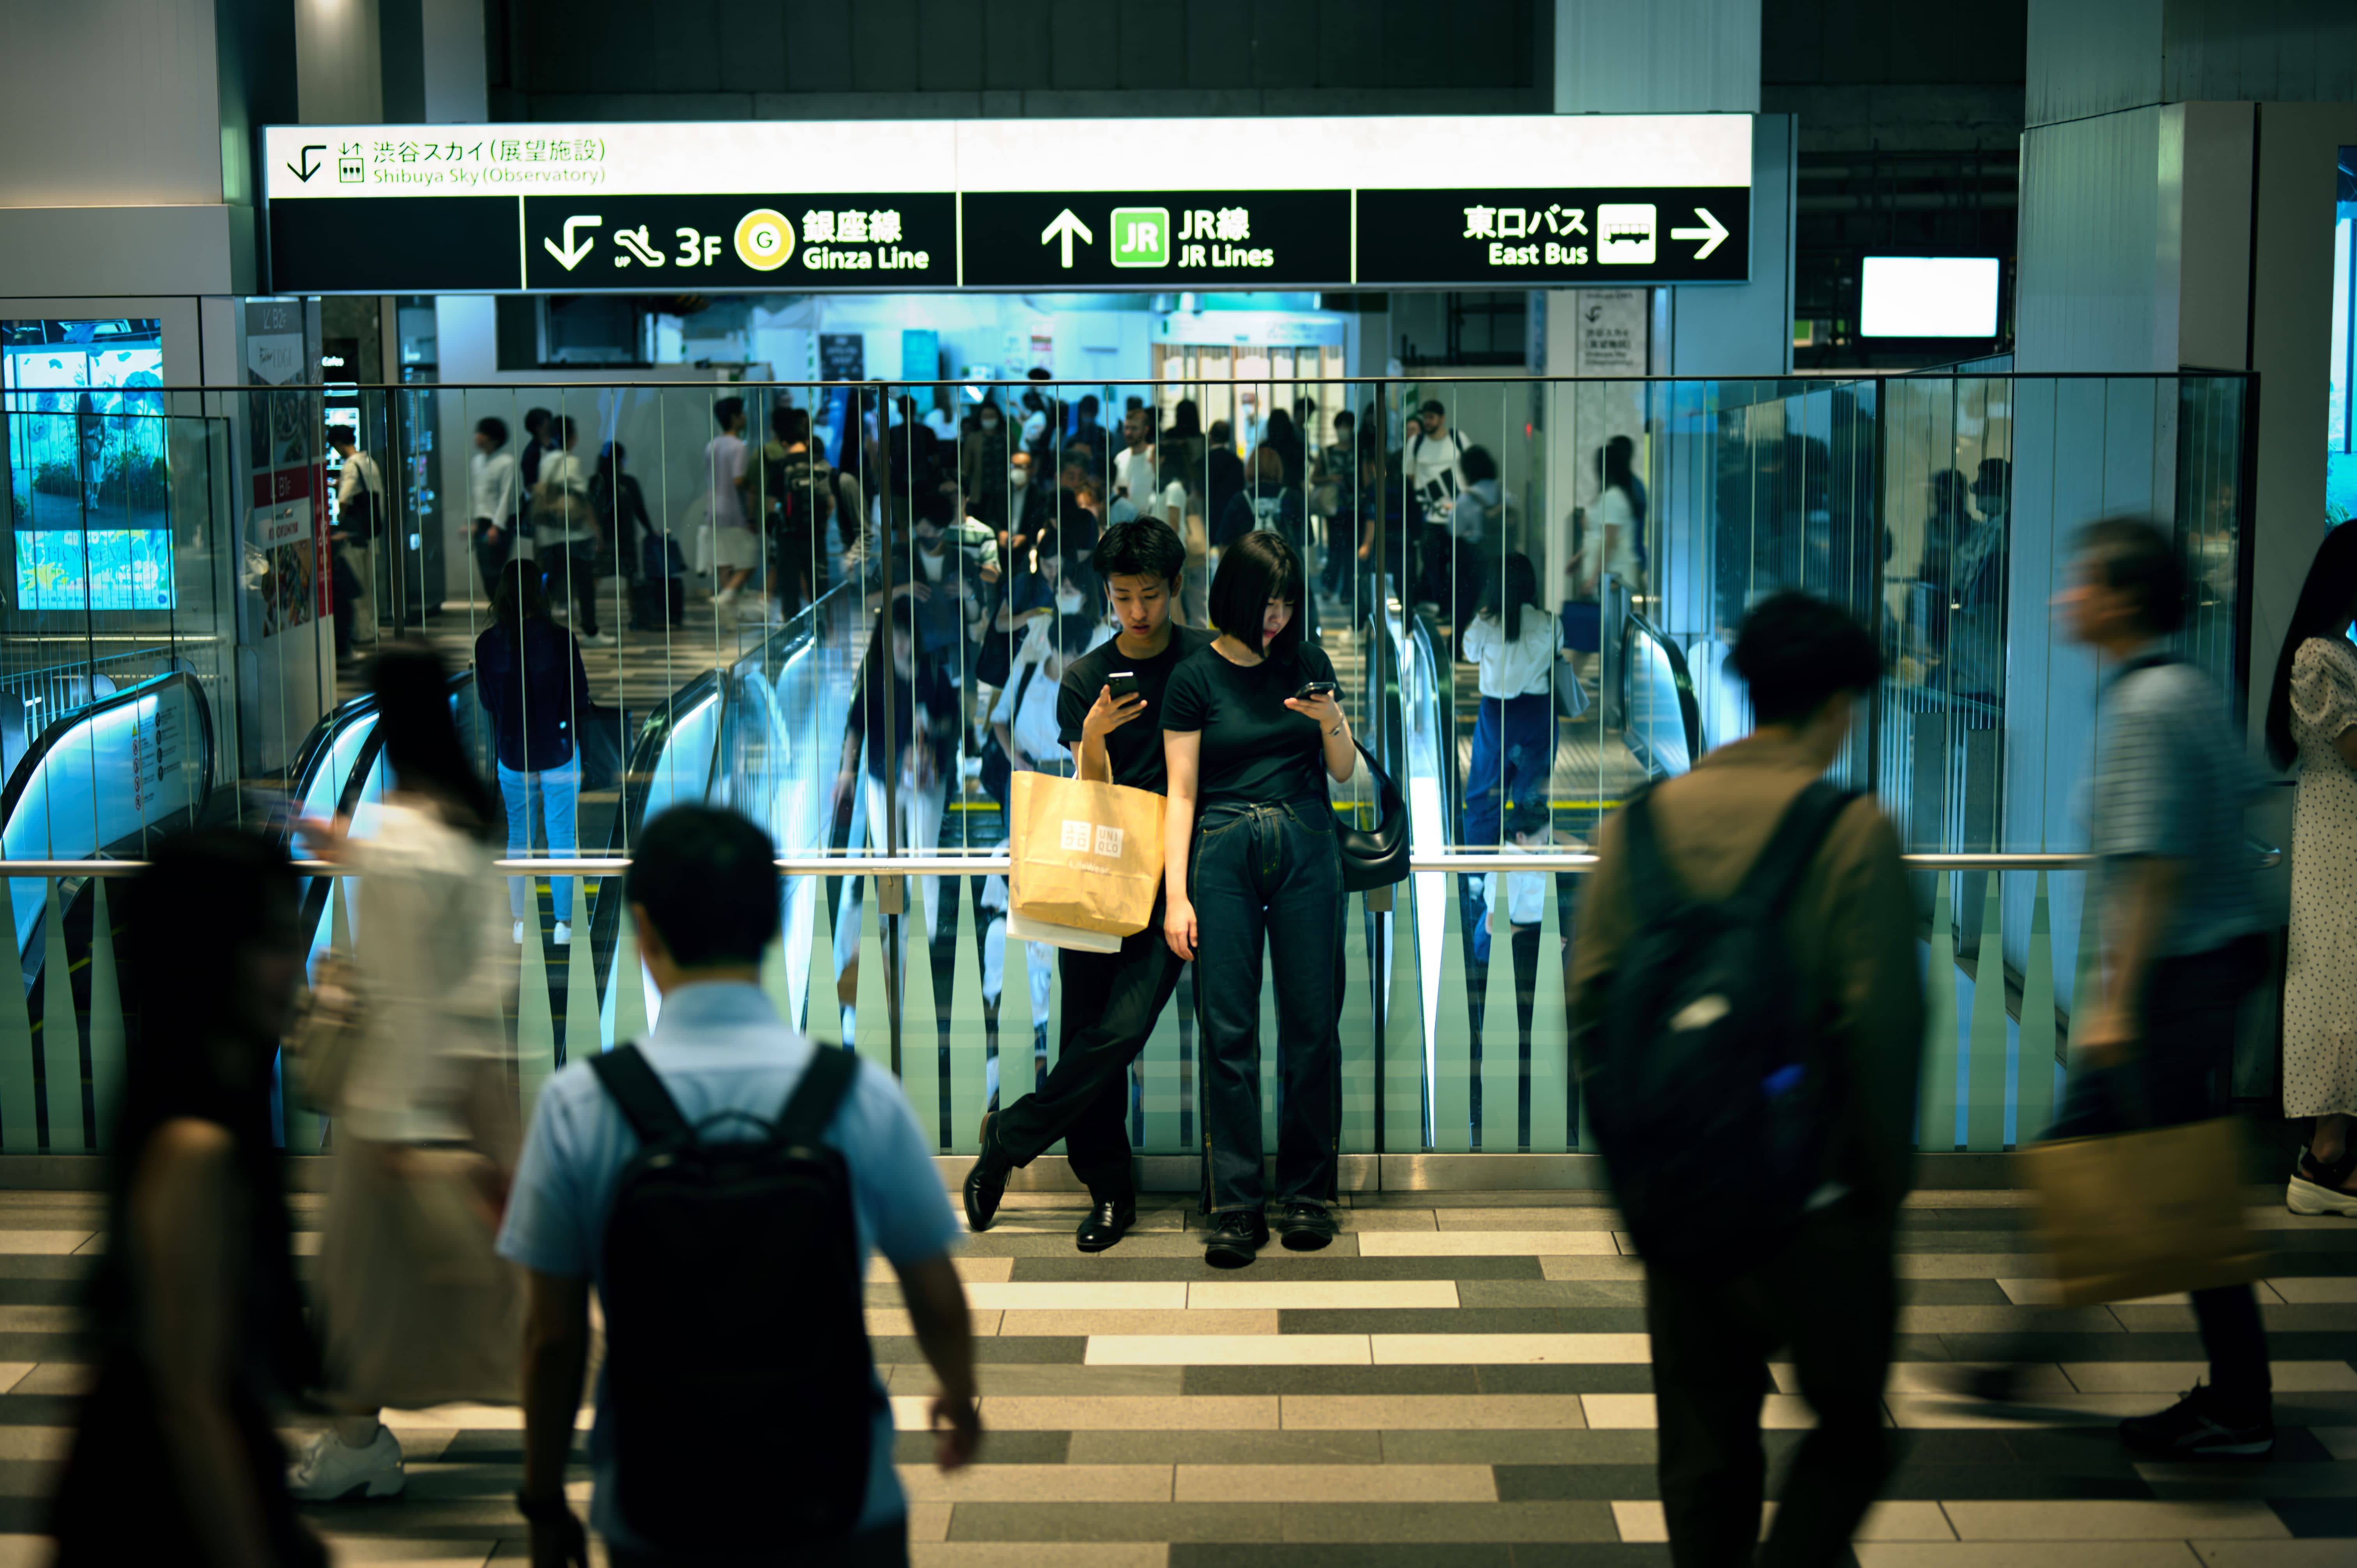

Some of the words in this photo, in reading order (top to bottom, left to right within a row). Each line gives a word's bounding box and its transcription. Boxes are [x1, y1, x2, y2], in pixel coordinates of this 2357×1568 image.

[374, 139, 605, 163] 渋谷スカイ(展望施設)
[374, 168, 443, 187] Shibuya
[802, 209, 902, 243] 銀座線
[1178, 207, 1249, 240] JR線
[1463, 204, 1588, 239] 東口バス
[676, 228, 721, 266] 3F
[757, 231, 773, 248] G
[1120, 222, 1159, 253] JR
[615, 256, 631, 267] UP
[803, 246, 872, 269] Ginza
[878, 246, 929, 269] Line
[1178, 245, 1207, 267] JR
[1212, 244, 1274, 267] Lines
[1489, 243, 1539, 265] East
[1545, 242, 1588, 265] Bus
